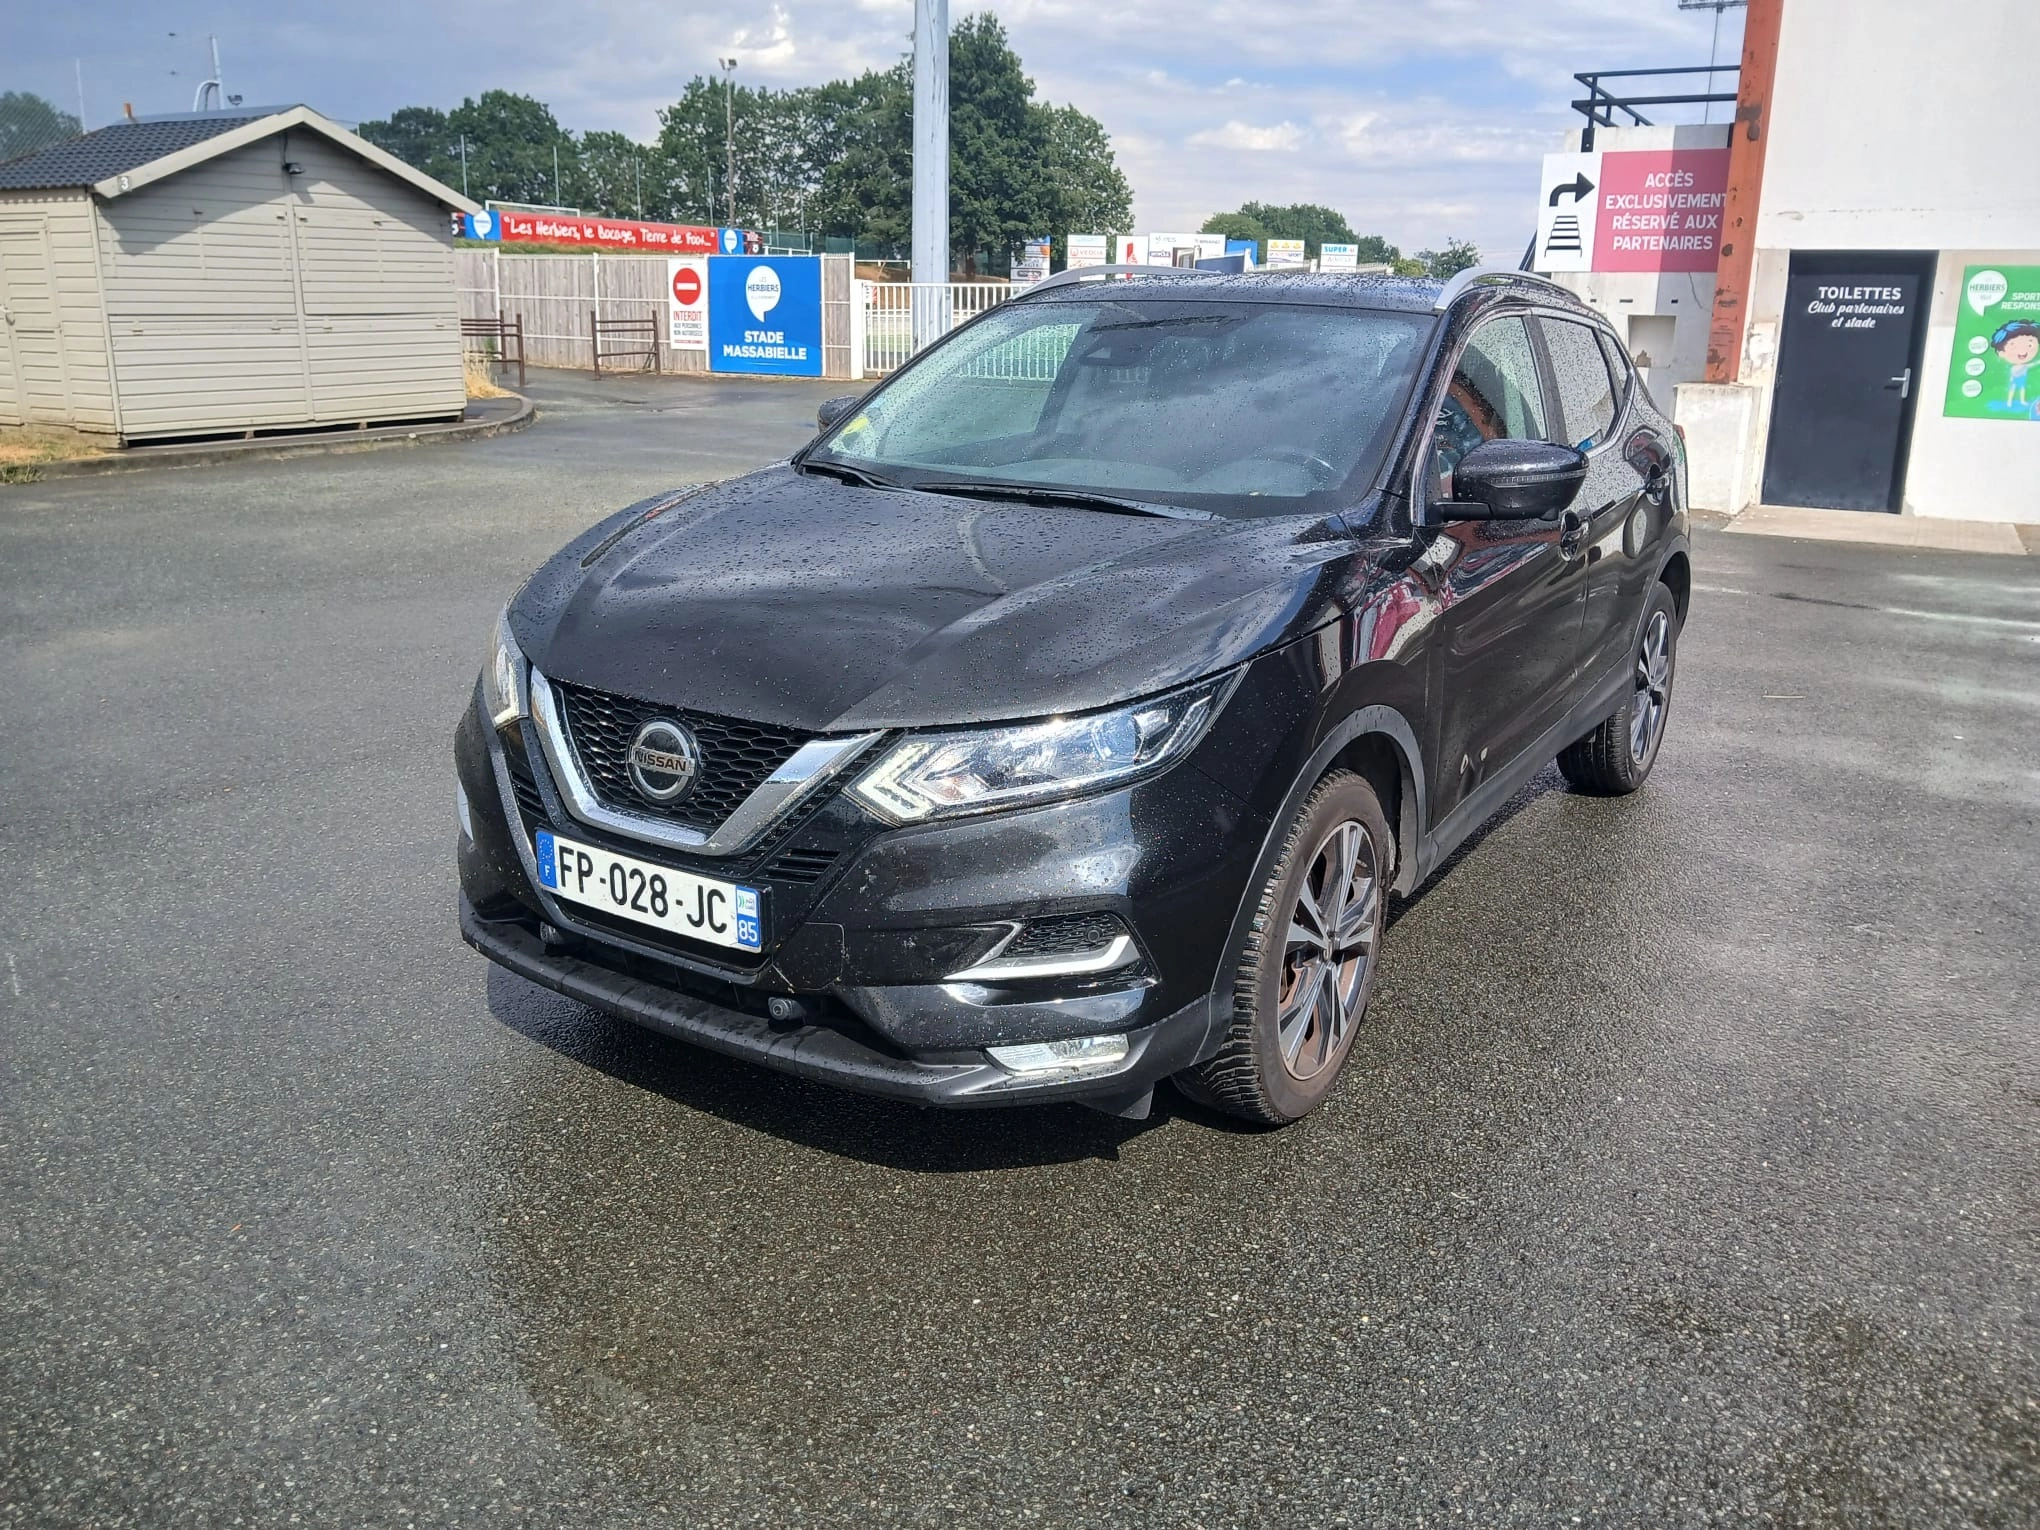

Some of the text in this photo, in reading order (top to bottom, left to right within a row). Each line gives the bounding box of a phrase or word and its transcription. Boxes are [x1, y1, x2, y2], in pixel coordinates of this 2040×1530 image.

[120, 176, 129, 190] 3
[1645, 169, 1694, 188] ACCÈS
[1613, 211, 1718, 229] RÉSERVÉ AUX
[583, 223, 595, 239] le
[639, 227, 669, 243] Terre
[670, 229, 684, 244] de
[1324, 245, 1348, 253] SUPER
[1613, 235, 1713, 250] PARTENAIRES
[747, 283, 780, 293] HERBIERS
[1818, 286, 1902, 300] TOILETTES
[1969, 283, 2006, 292] HERBIERS
[1807, 300, 1905, 317] Club partenaires
[673, 311, 703, 322] INTERDIT
[1831, 316, 1877, 329] et stade
[744, 330, 786, 344] STADE
[723, 344, 808, 361] MASSABIELLE
[634, 749, 687, 772] NISSAN
[544, 864, 551, 877] F
[558, 844, 728, 934] FP-028-JC
[738, 919, 759, 943] 85
